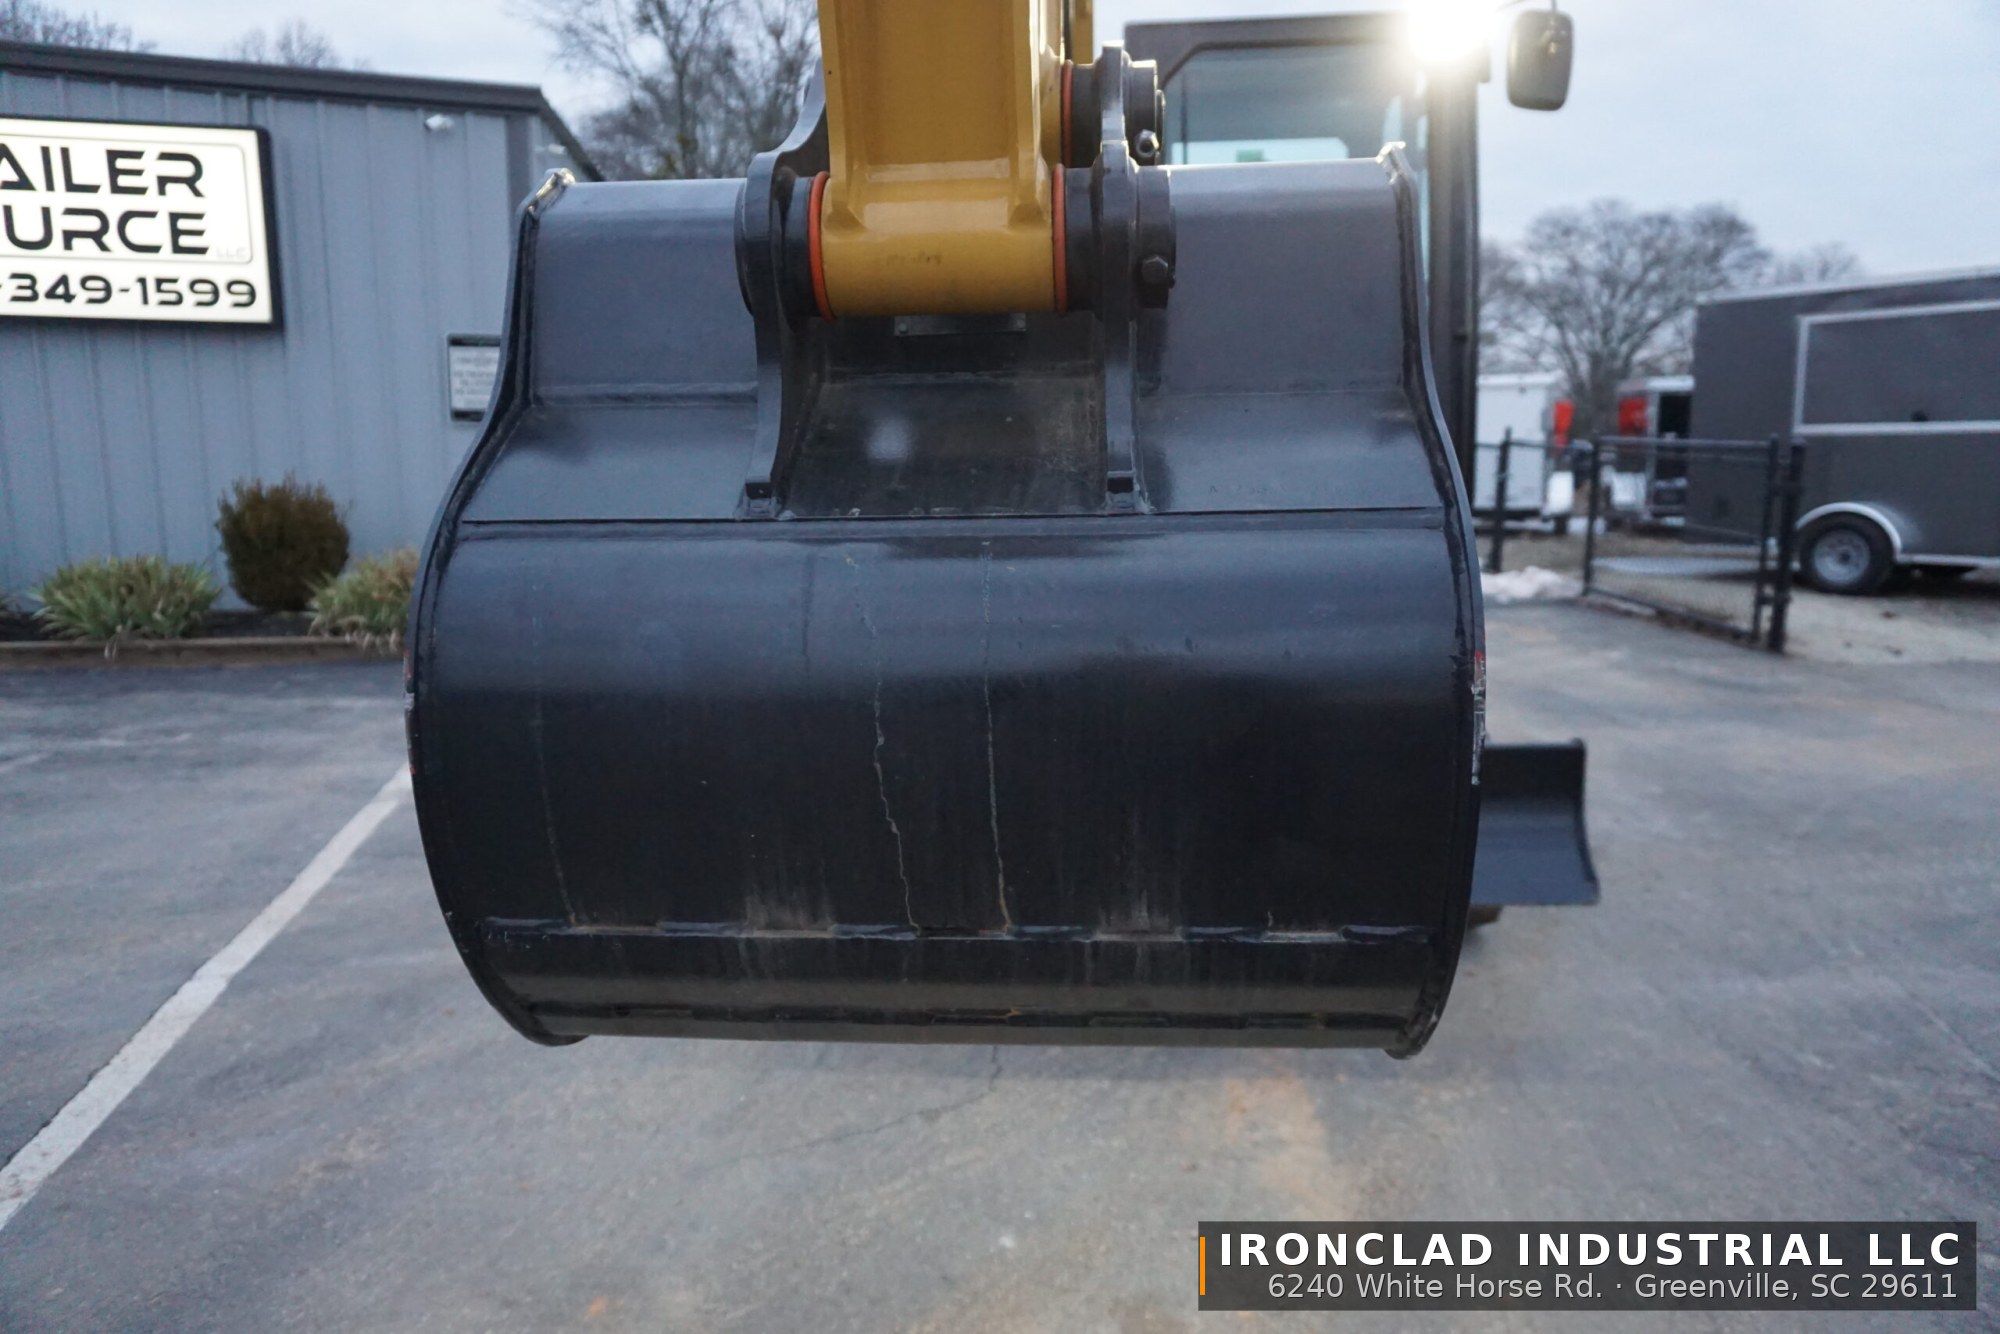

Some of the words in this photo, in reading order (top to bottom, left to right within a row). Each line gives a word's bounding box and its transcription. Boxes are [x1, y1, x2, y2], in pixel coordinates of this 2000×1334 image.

[0, 143, 205, 197] AILER
[3, 204, 209, 255] URCE
[0, 272, 256, 308] 349-1599
